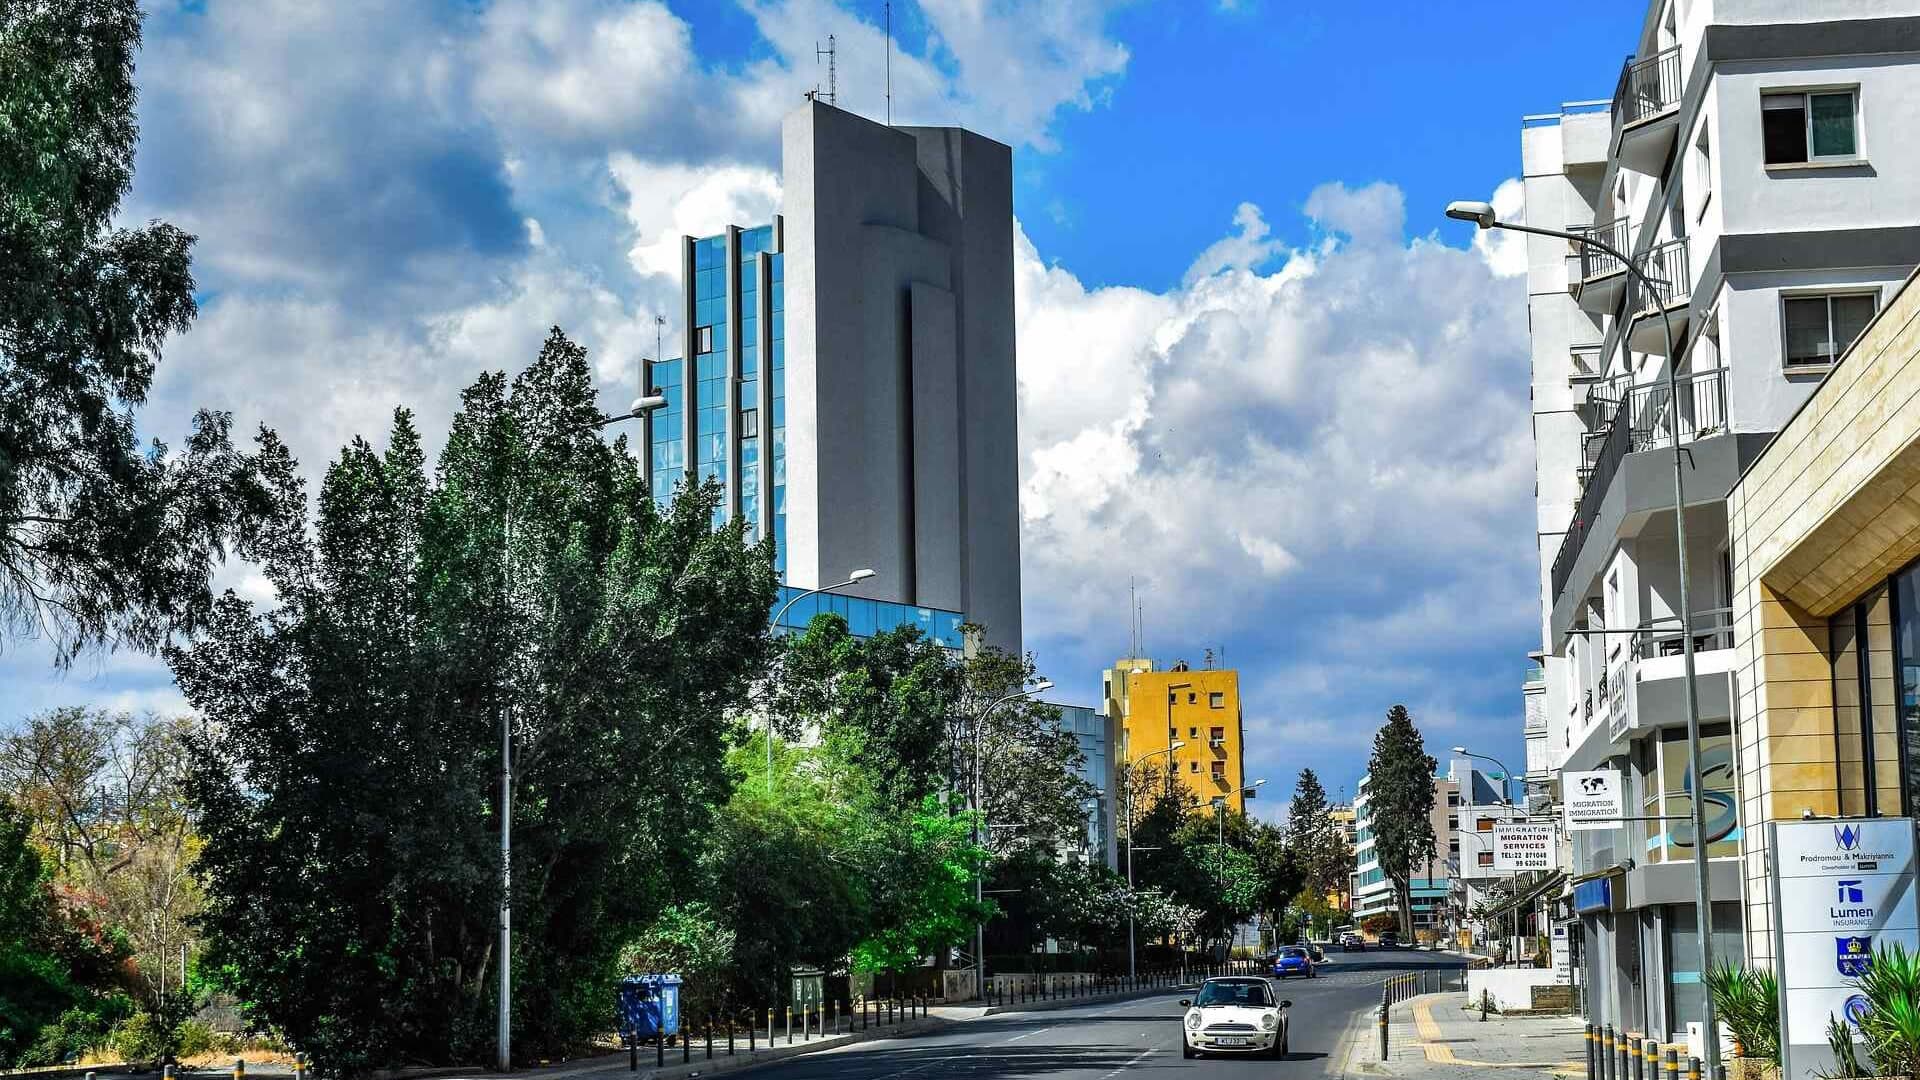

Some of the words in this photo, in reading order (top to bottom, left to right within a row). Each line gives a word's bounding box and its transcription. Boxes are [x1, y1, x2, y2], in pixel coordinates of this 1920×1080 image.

[1572, 800, 1614, 808] MIGRATION
[1568, 807, 1618, 817] IMMIGRATION
[1800, 853, 1842, 862] Prodromou
[1830, 907, 1874, 918] Lumen
[1833, 919, 1872, 927] INSURANCE
